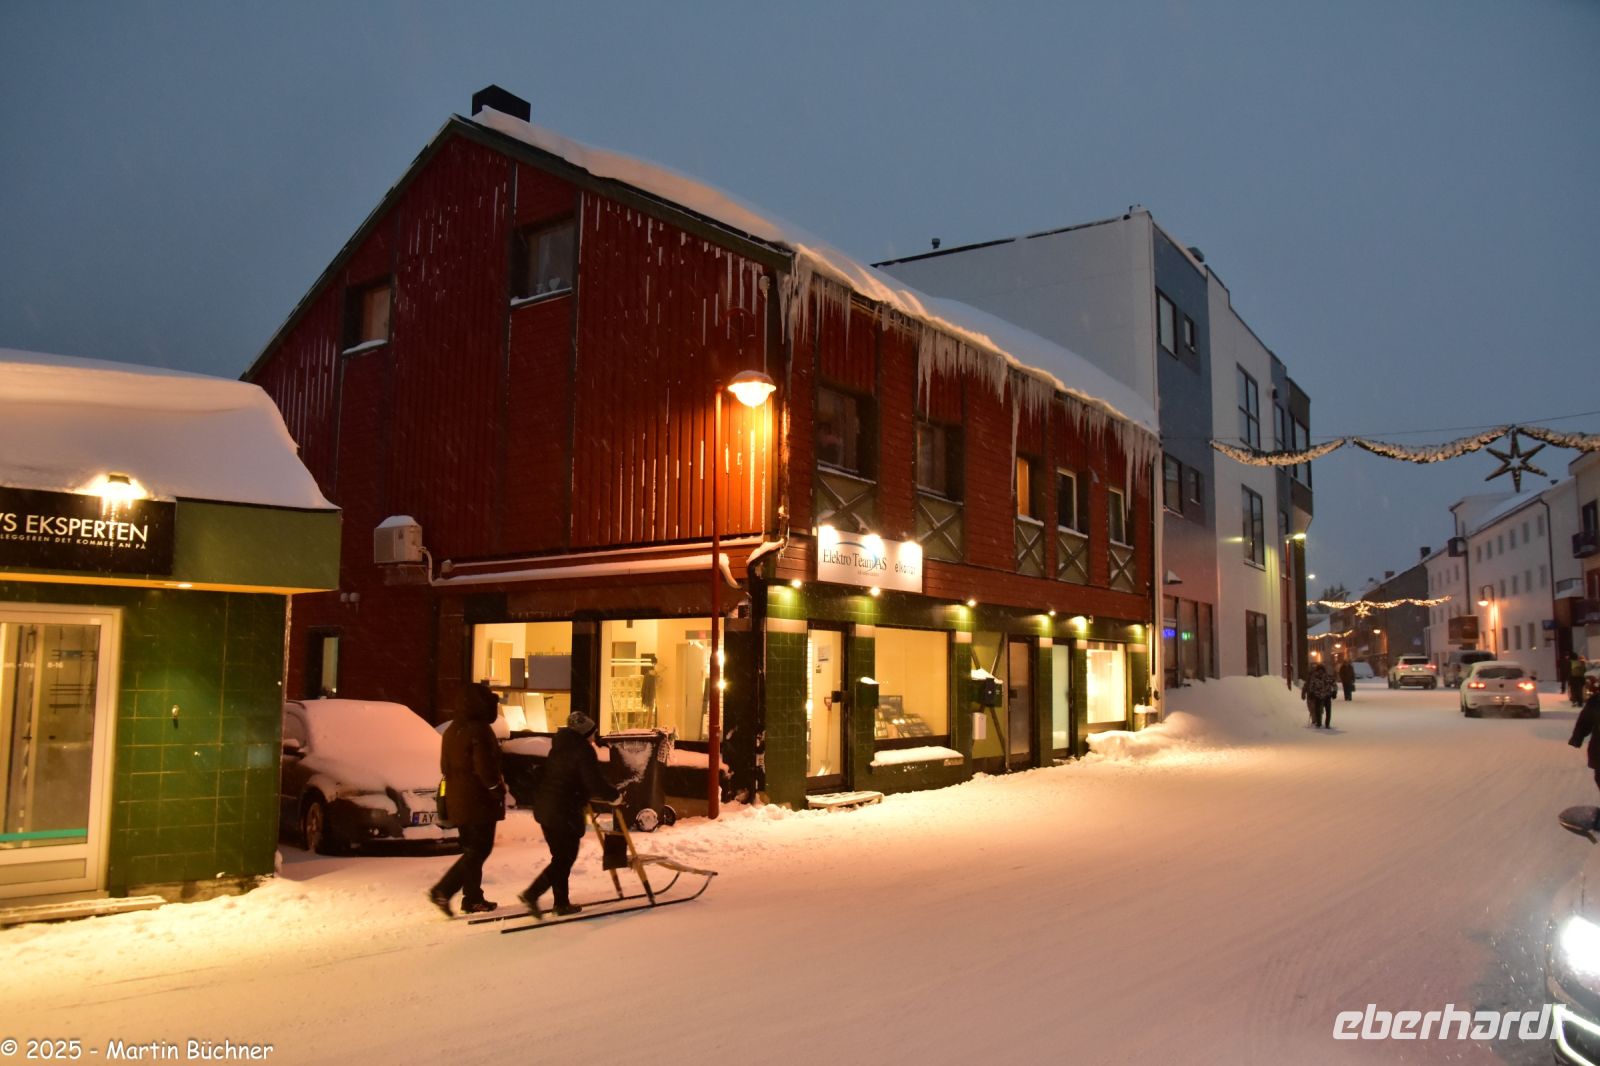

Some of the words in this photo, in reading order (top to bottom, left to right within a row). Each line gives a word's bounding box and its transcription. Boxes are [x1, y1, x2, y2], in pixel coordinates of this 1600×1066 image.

[26, 515, 148, 542] EKSPERTEN
[76, 538, 114, 547] KOMMER
[823, 548, 852, 566] Elektro
[852, 553, 874, 569] Team
[875, 554, 887, 571] AS
